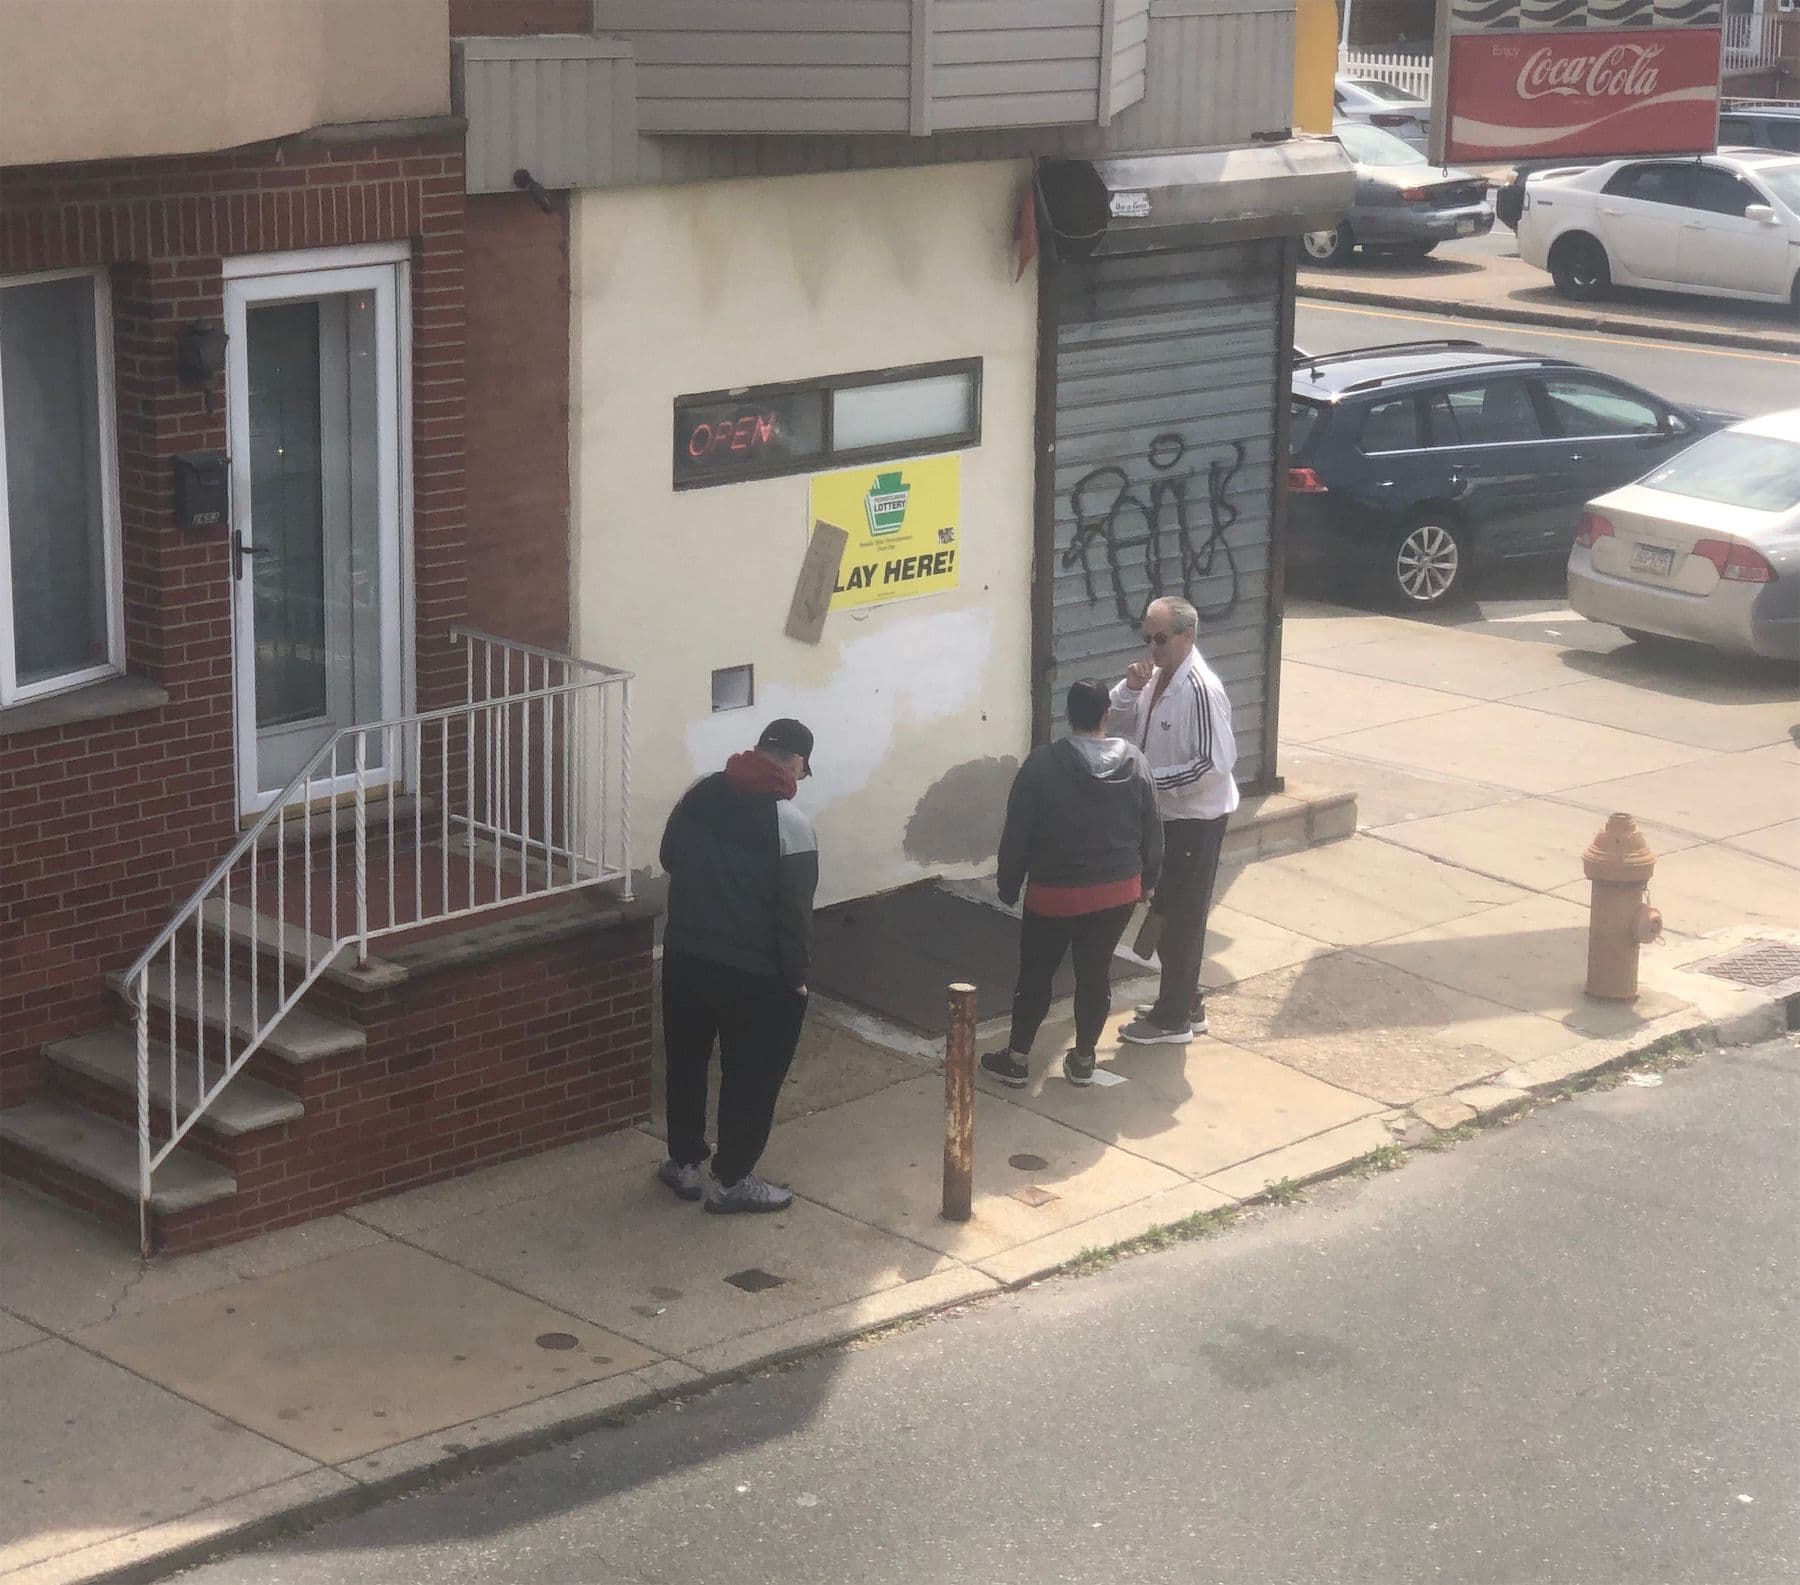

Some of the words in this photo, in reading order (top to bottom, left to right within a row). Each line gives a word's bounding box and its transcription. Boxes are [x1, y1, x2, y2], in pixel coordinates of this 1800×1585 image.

[1516, 44, 1665, 100] Coca-Cola
[688, 411, 777, 457] OPEN
[874, 499, 906, 512] LOTTERY
[832, 563, 878, 593] LAY
[883, 550, 955, 584] HERE!
